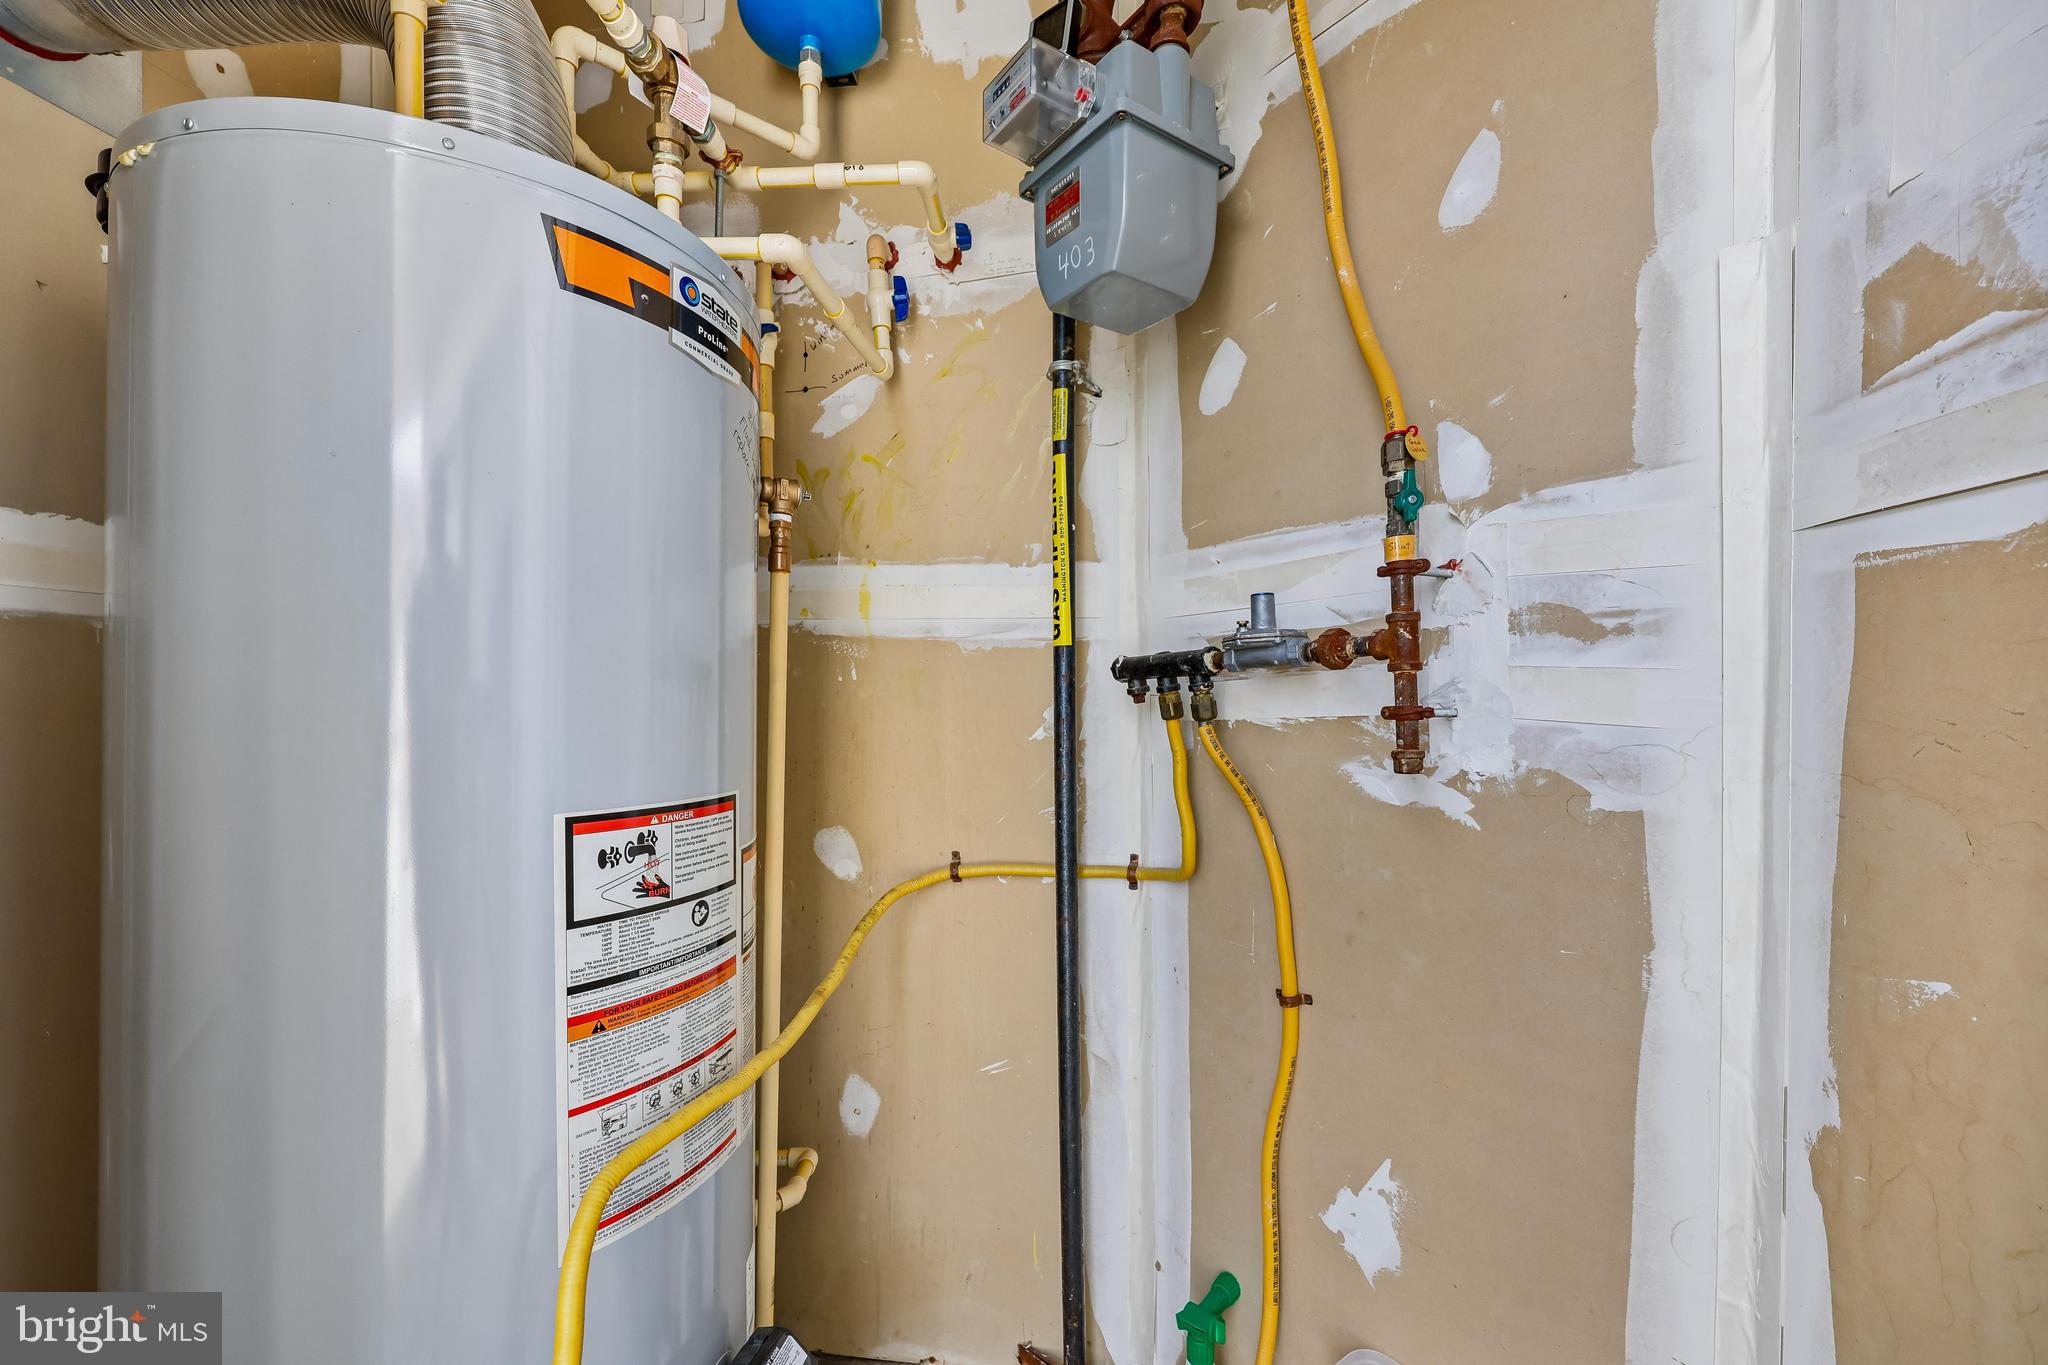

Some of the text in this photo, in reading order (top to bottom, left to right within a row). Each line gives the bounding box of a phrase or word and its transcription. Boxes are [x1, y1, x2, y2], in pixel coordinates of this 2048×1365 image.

[1058, 236, 1095, 279] 403
[701, 292, 738, 333] state
[698, 325, 726, 352] ProLine
[684, 341, 734, 376] COMMERCIAL GRADE
[1388, 542, 1410, 551] Shut
[662, 812, 694, 824] DANGER
[649, 887, 671, 897] BURN
[580, 928, 612, 938] TEMPERATURE
[603, 1006, 619, 1018] FOR
[621, 1000, 640, 1012] YOUR
[642, 990, 666, 1006] SAFETY
[667, 984, 683, 997] READ
[637, 1071, 669, 1092] LIGHTING
